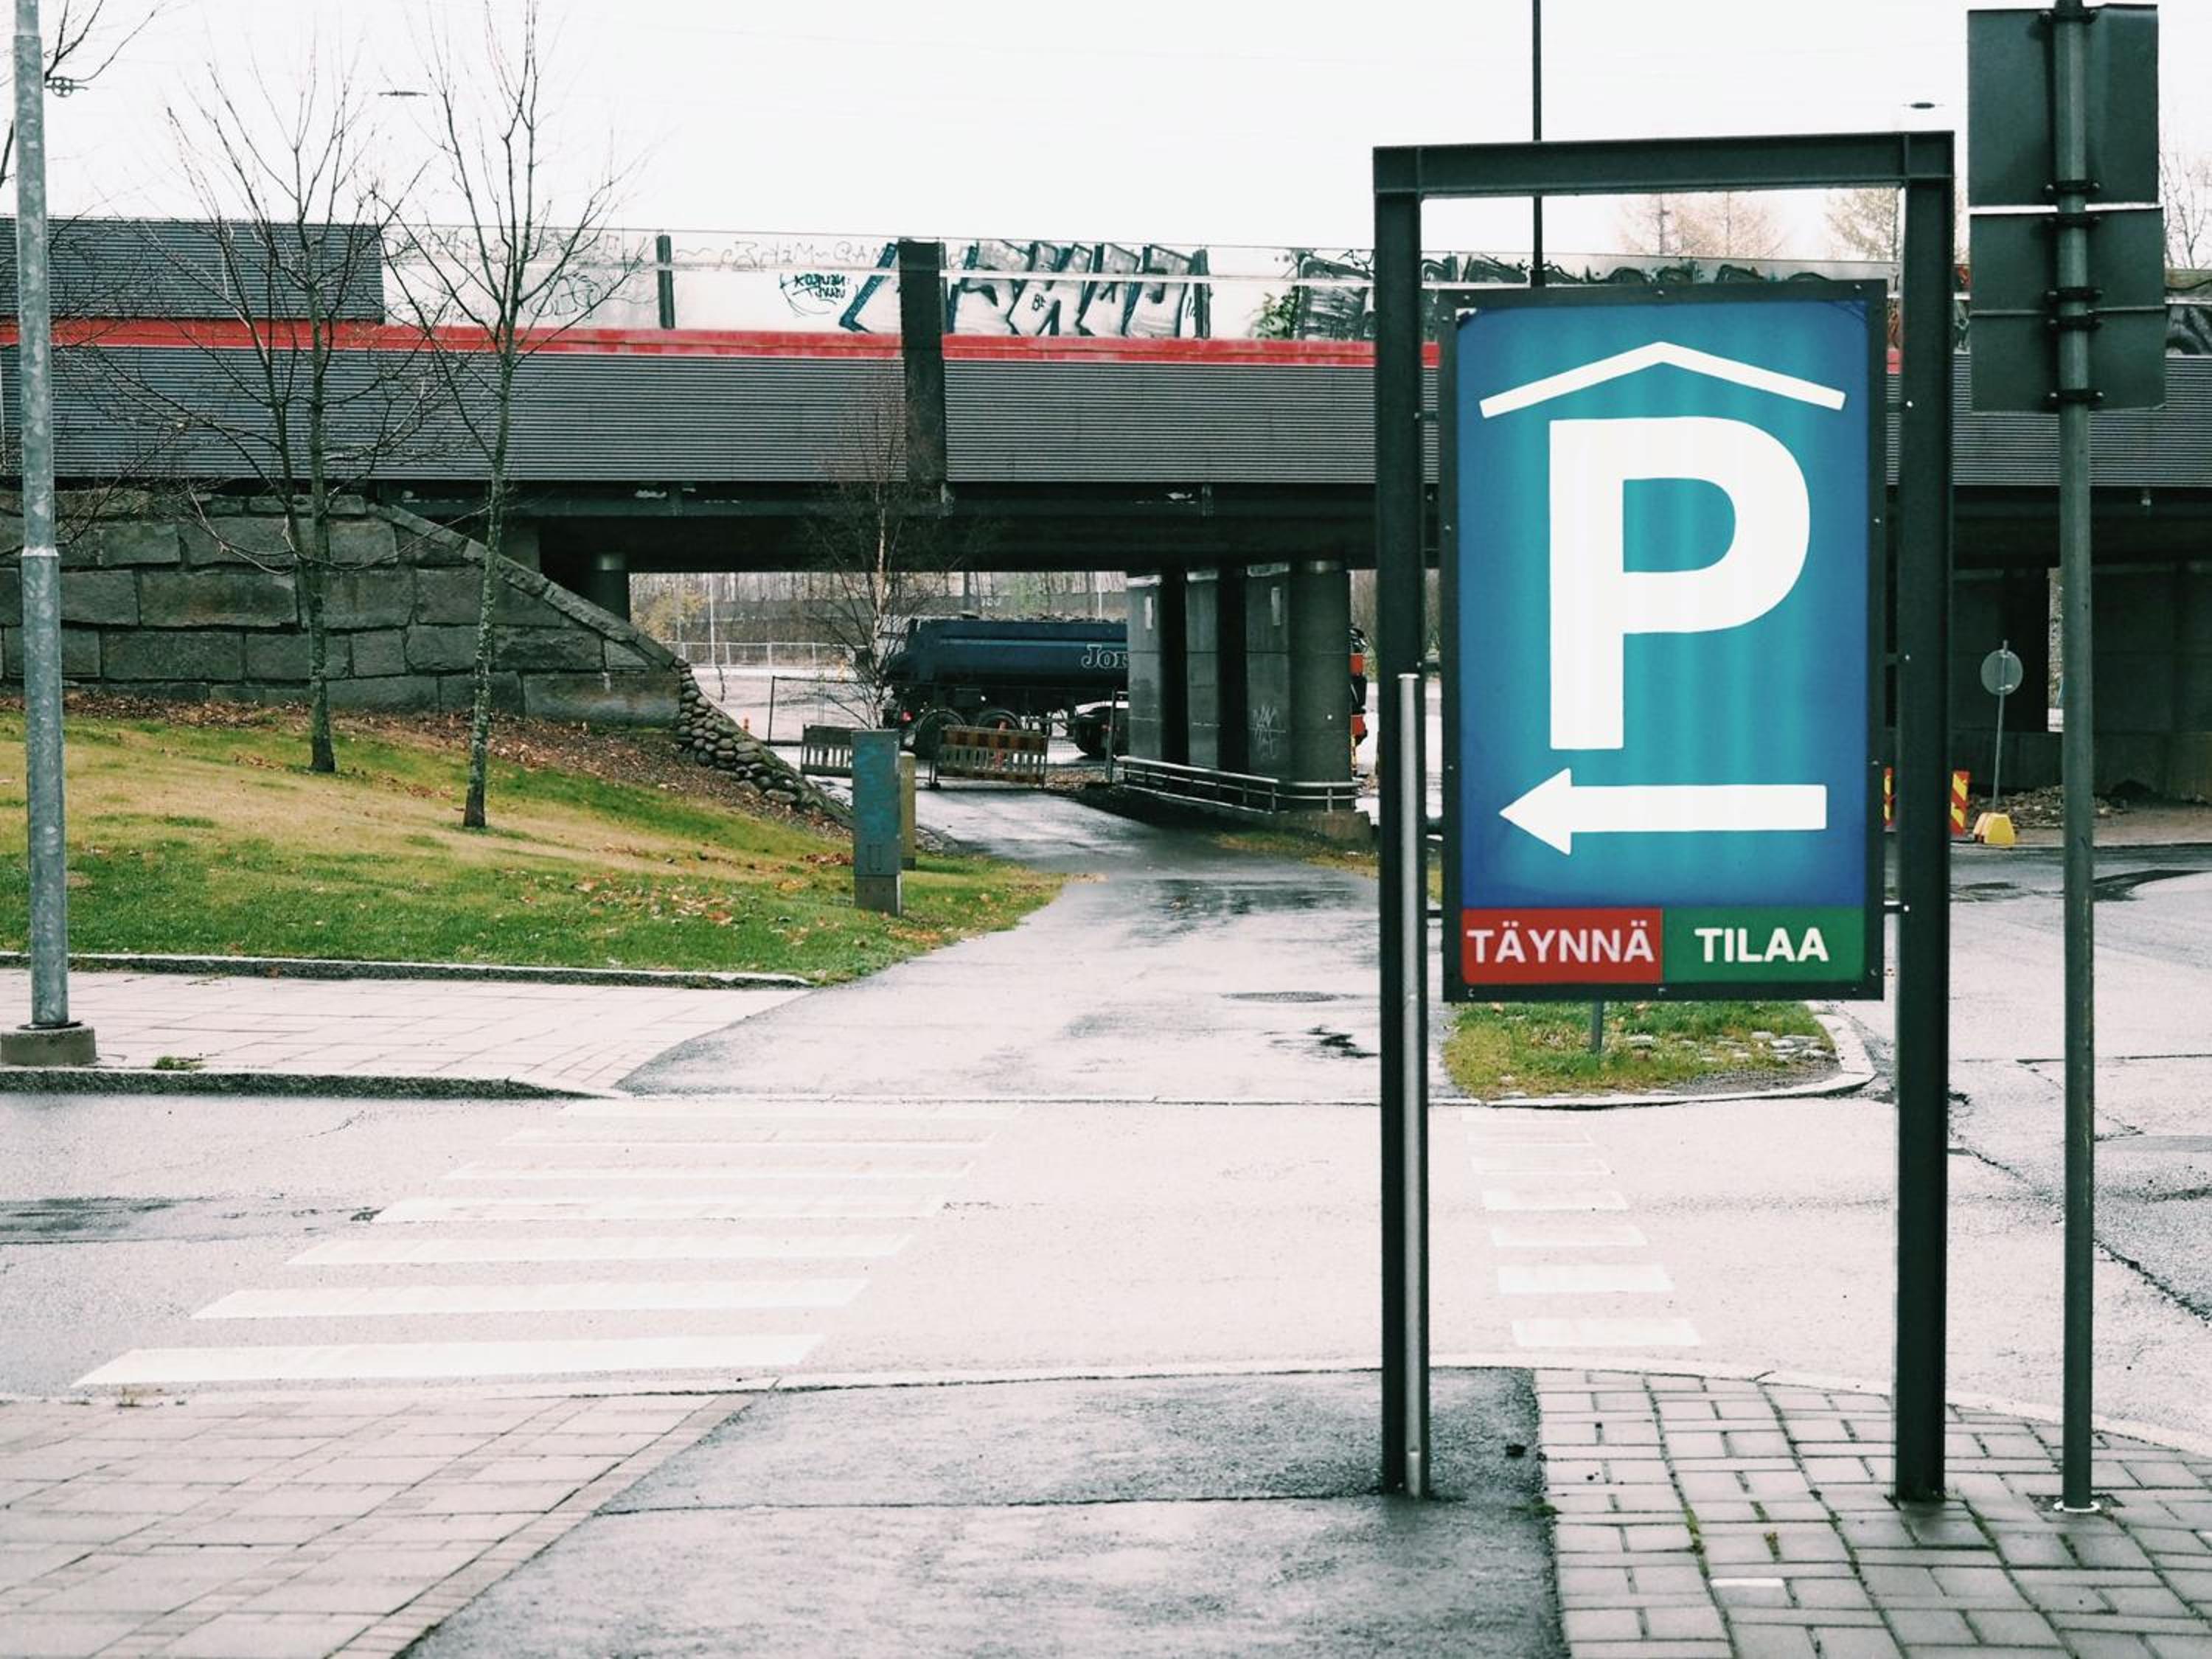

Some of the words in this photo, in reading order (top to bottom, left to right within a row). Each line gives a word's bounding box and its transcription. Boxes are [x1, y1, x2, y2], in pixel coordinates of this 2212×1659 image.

[1549, 417, 1810, 750] P
[1466, 919, 1655, 963] TÄYNNÄ
[1694, 927, 1829, 962] TILAA
